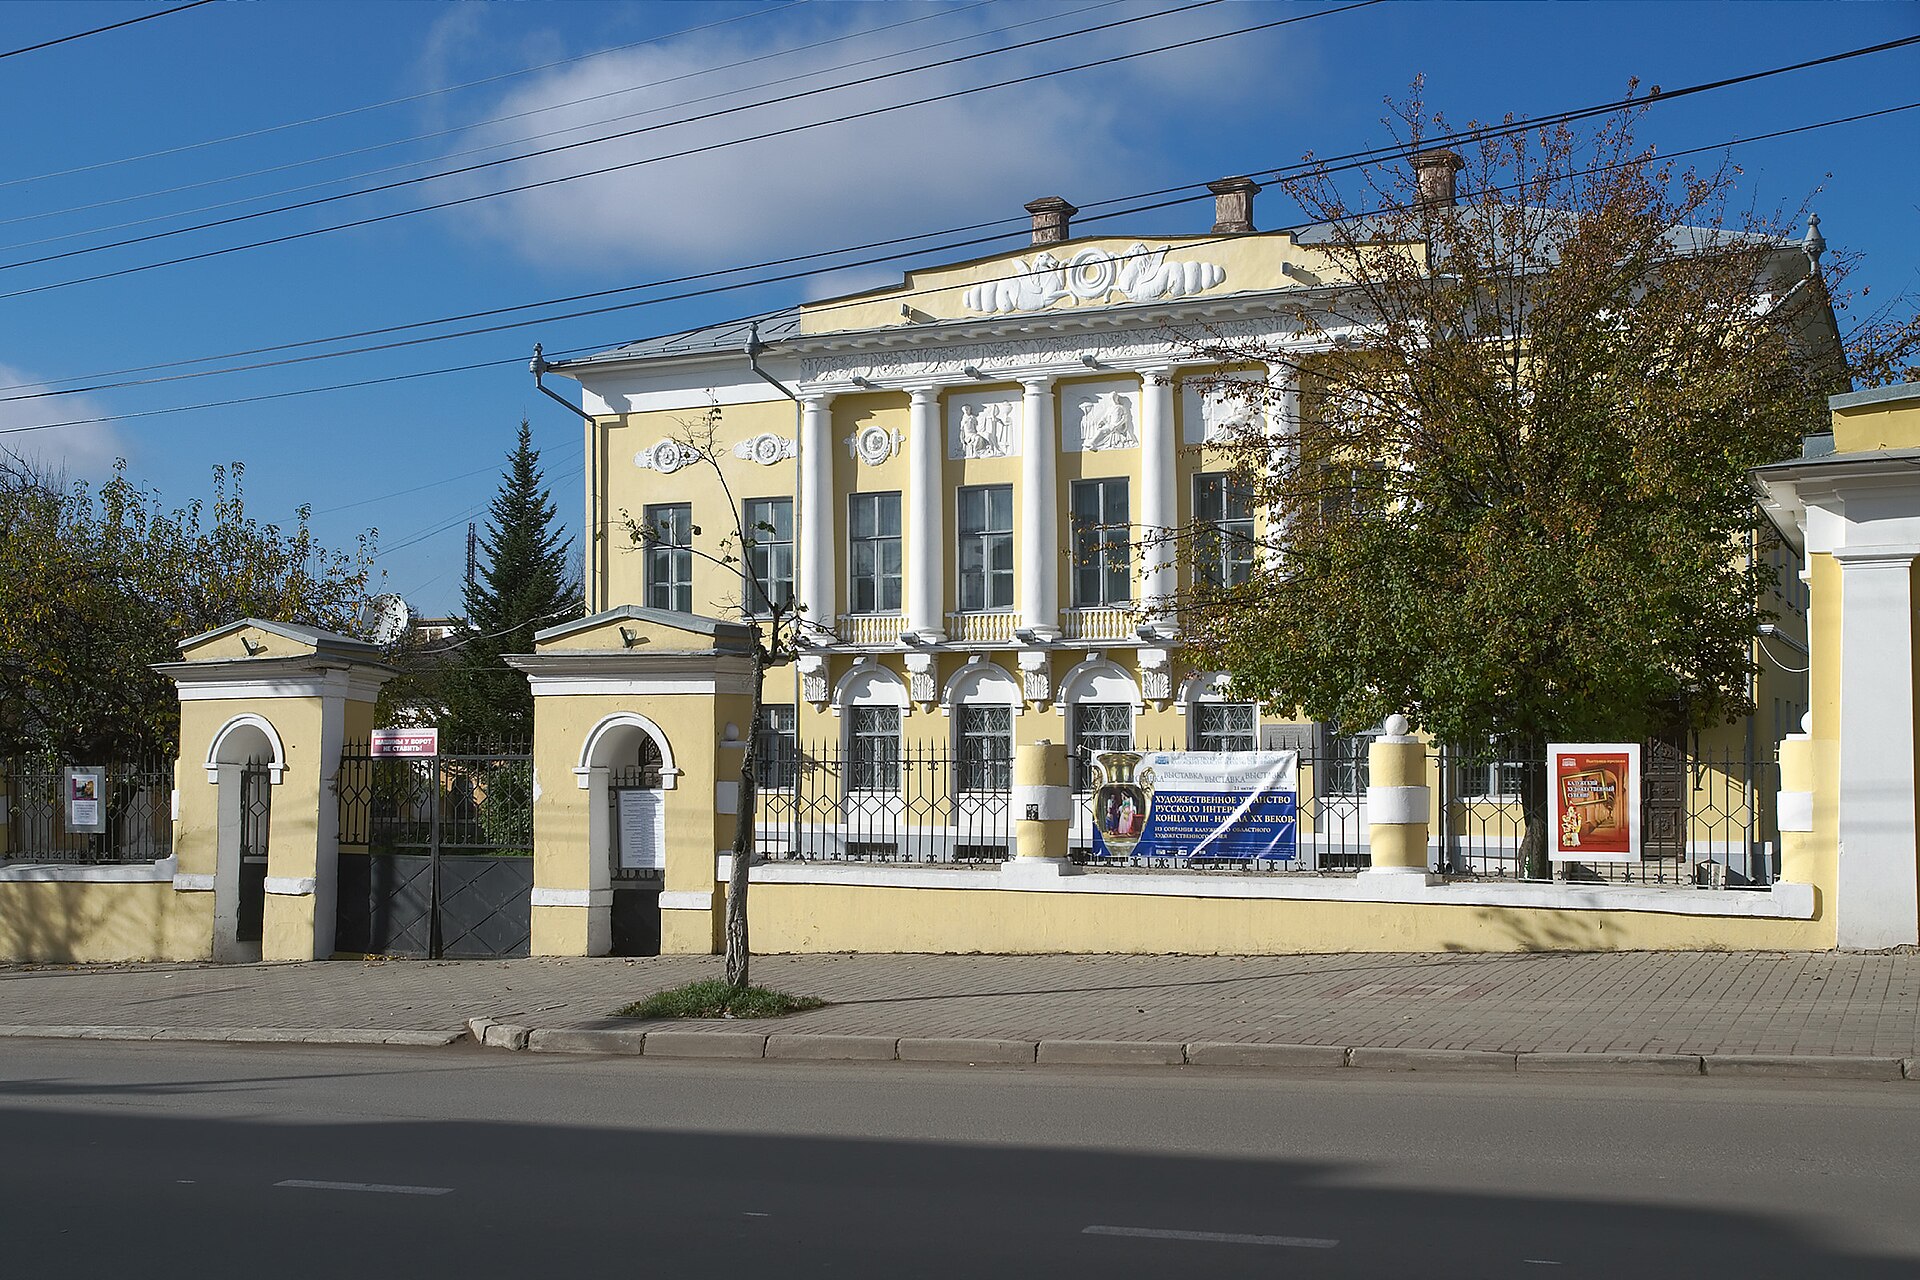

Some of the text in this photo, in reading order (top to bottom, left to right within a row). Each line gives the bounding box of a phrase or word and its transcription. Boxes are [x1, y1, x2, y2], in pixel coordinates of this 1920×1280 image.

[1164, 771, 1204, 779] ВЫСТАВКА
[1204, 775, 1246, 783] ВЫСТАВКА
[1155, 795, 1291, 804] ХУДОЖЕСТВЕННОЕ УАНСТВО
[1155, 805, 1251, 813] РУССКОГО ИНТЕРА
[1155, 814, 1187, 823] КОНЦА
[1251, 815, 1263, 823] XX
[1264, 815, 1294, 823] ВЕКОВ
